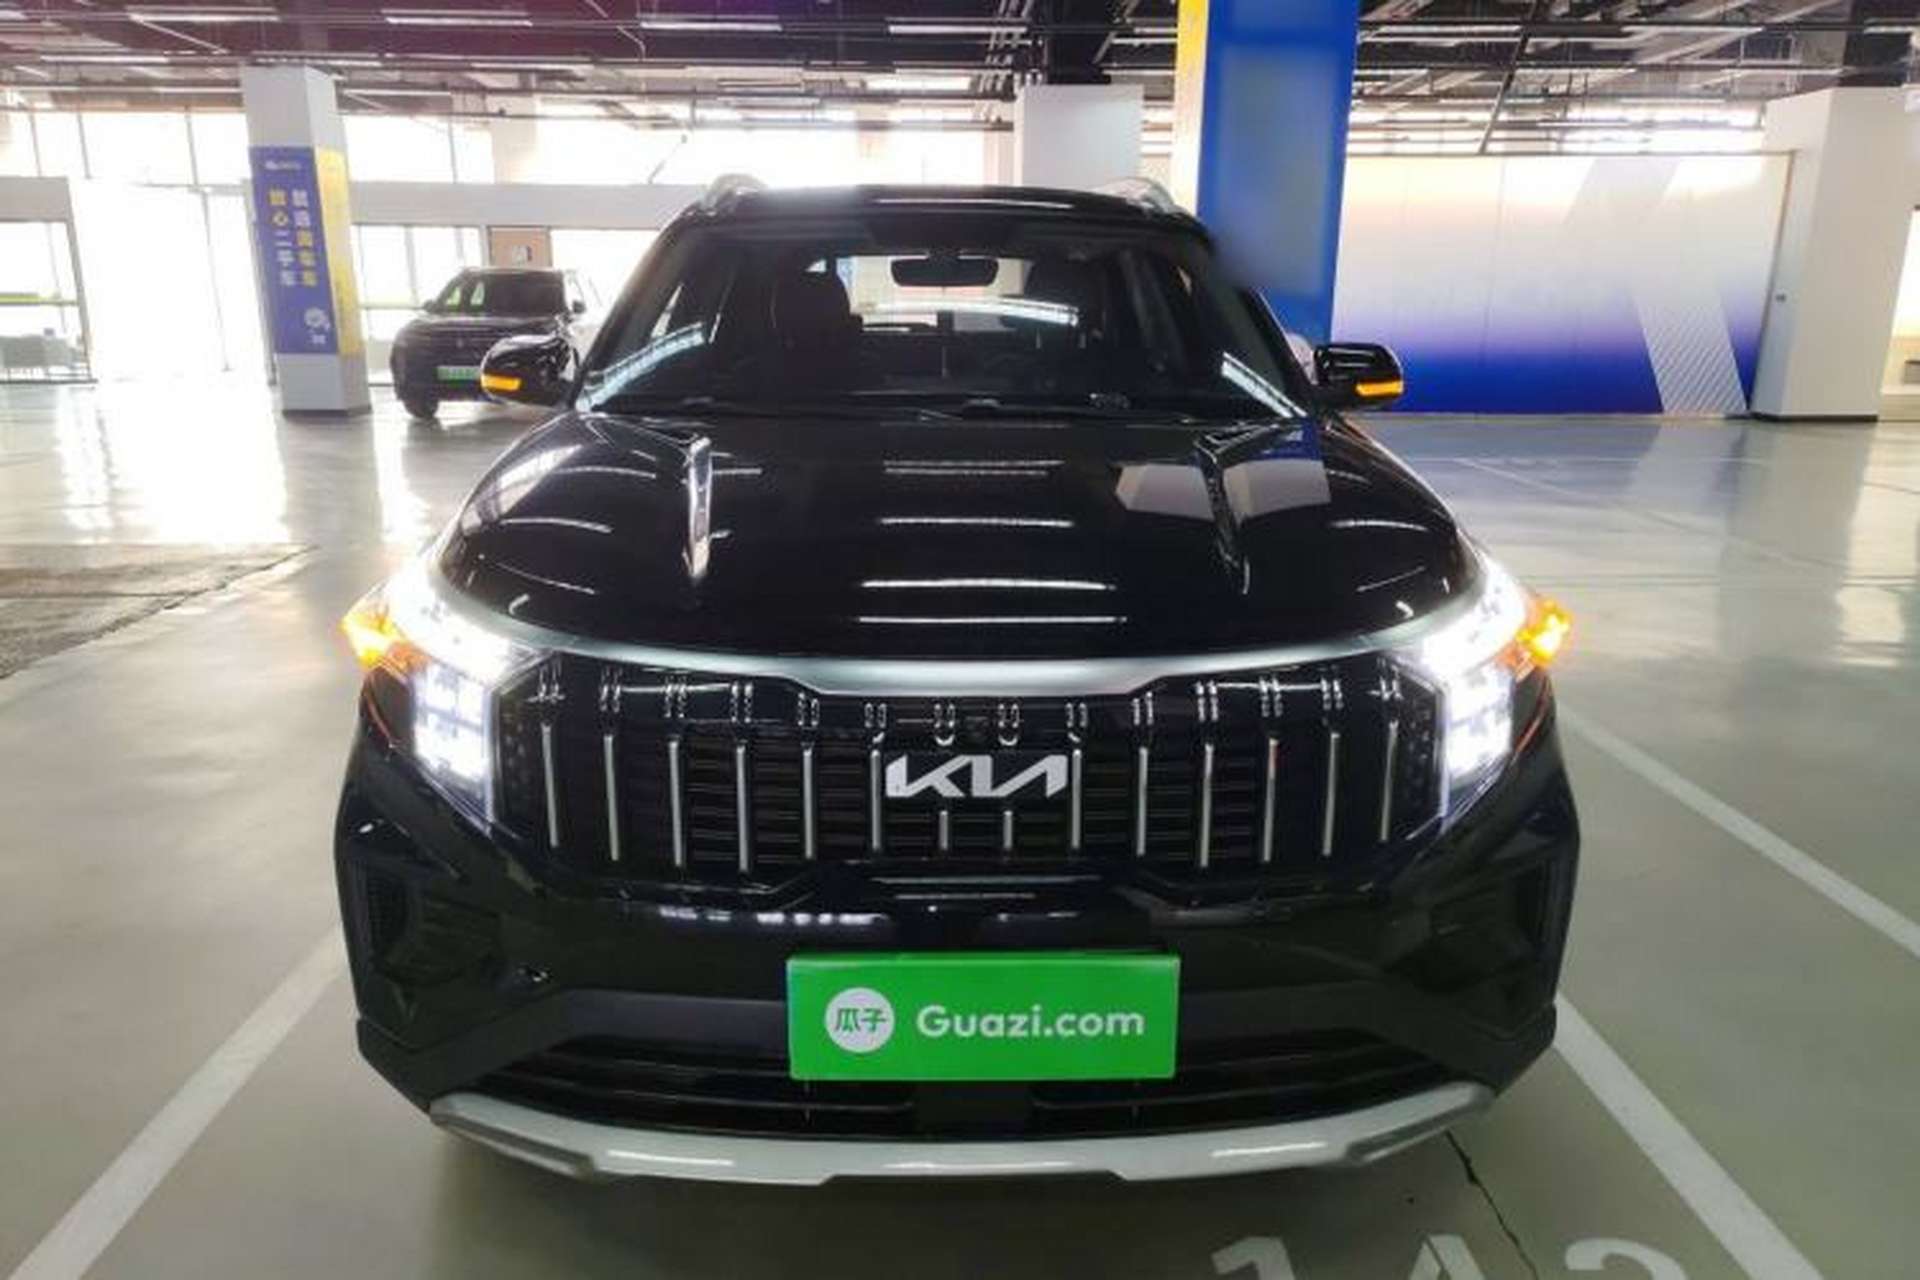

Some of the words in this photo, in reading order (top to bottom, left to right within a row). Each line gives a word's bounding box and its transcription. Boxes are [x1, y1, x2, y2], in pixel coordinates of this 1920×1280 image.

[885, 754, 1069, 798] KIA
[834, 1006, 888, 1033] 瓜子
[916, 1004, 1145, 1038] Guazi.com
